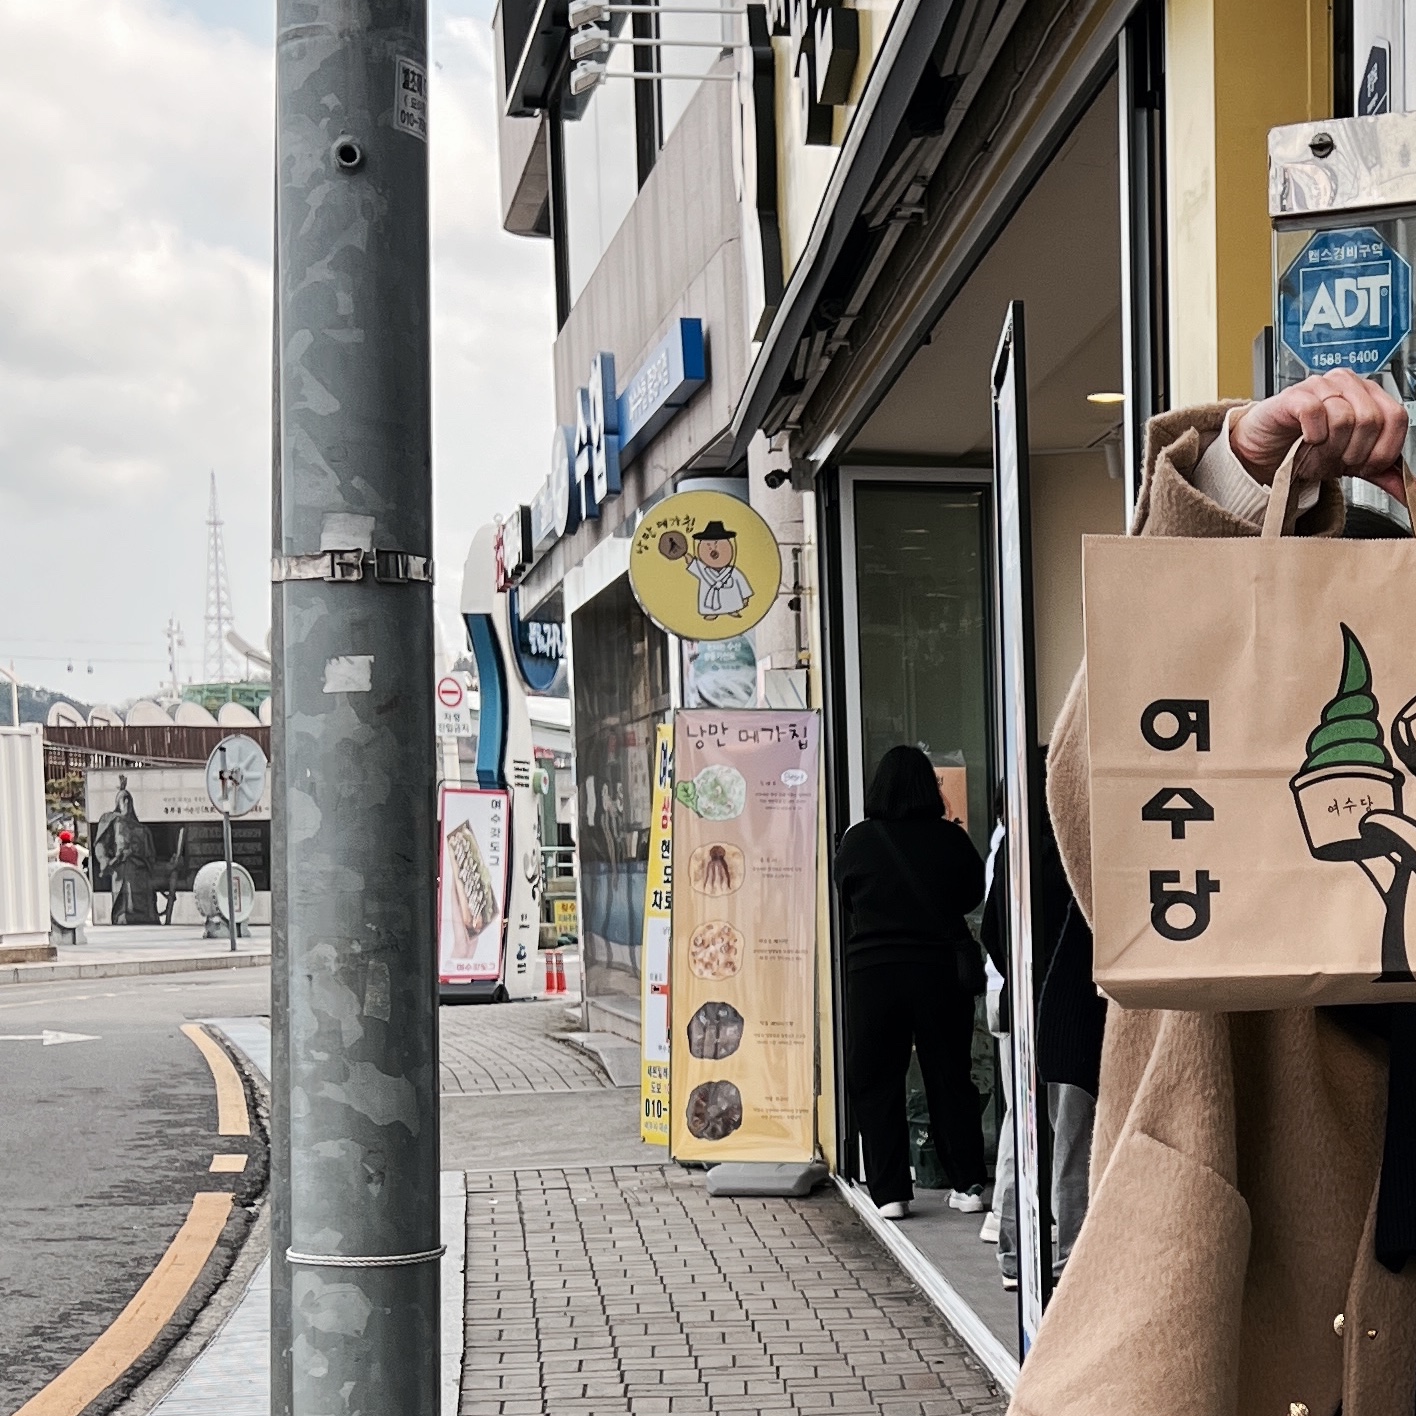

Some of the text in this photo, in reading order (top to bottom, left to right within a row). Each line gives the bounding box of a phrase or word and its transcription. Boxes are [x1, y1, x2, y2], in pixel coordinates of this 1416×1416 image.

[1308, 241, 1384, 264] 캡스경비구역
[1302, 274, 1390, 333] ADT
[1312, 349, 1379, 367] 1588-6400
[687, 722, 728, 750] 낭만
[1327, 795, 1373, 817] 여수당
[1140, 698, 1220, 942] 여수당
